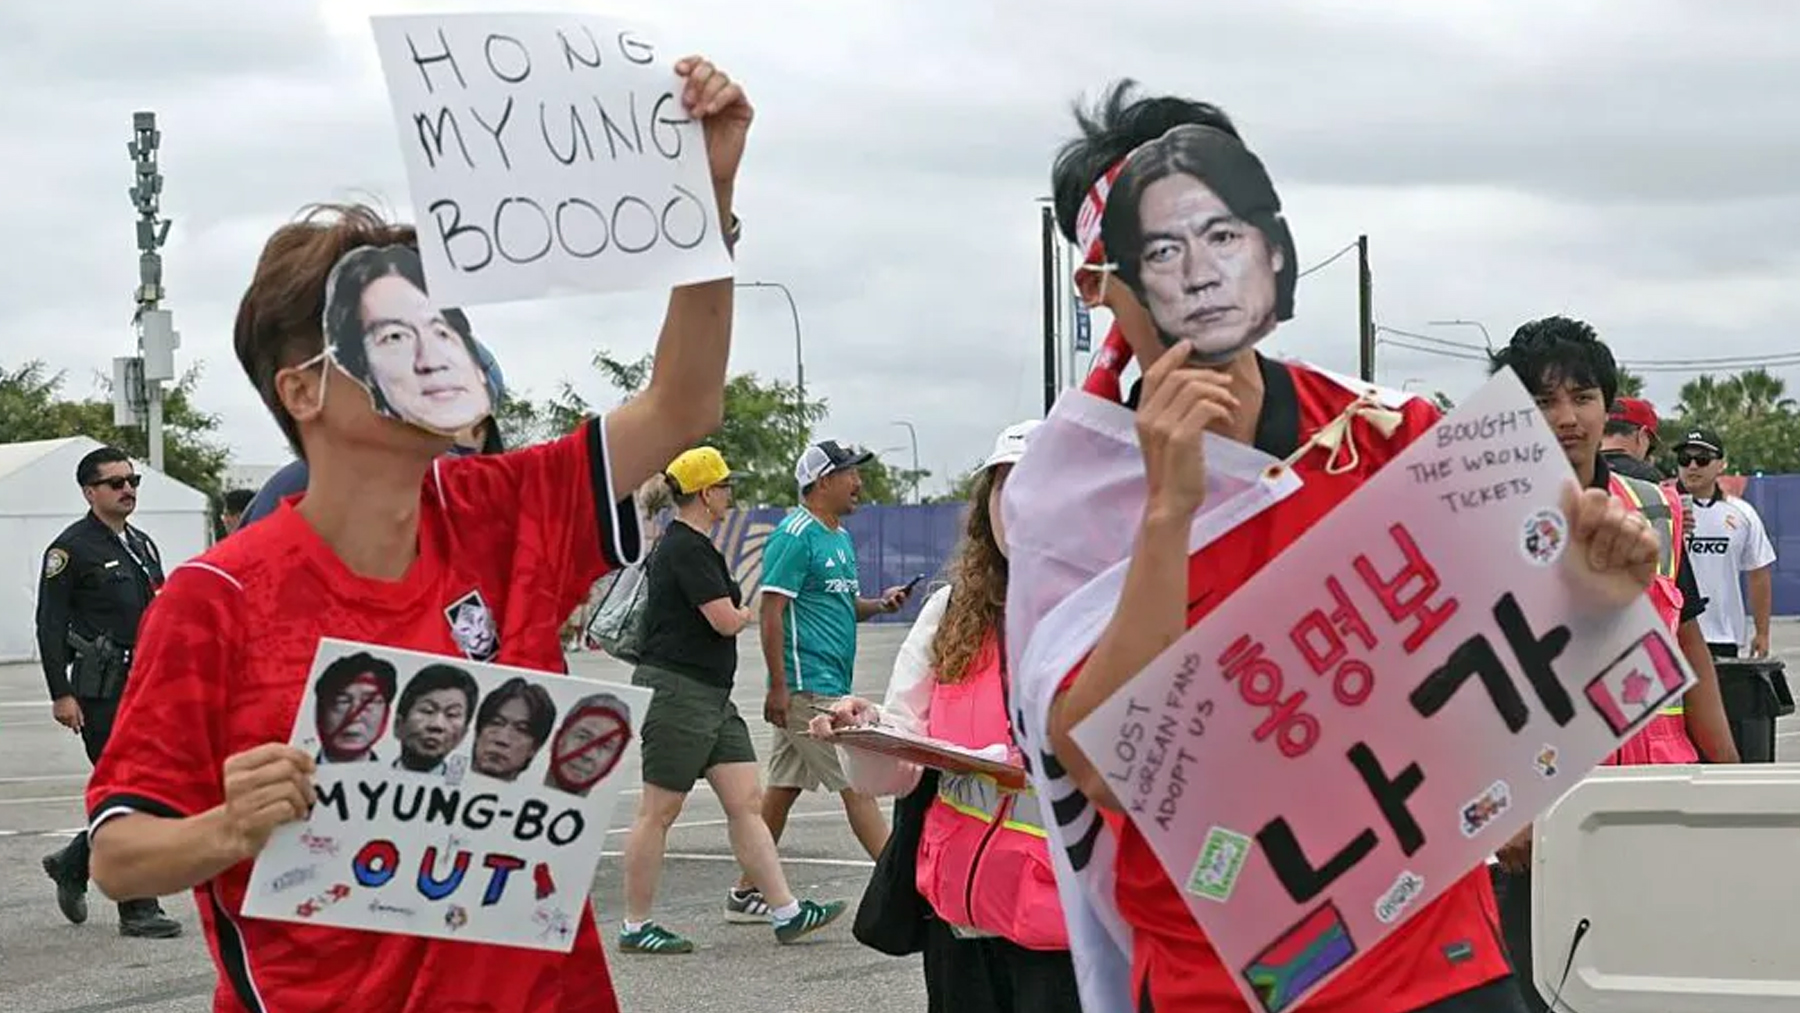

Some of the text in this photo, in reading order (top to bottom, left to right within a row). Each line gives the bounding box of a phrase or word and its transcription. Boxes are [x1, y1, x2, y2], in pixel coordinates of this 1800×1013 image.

[406, 26, 654, 93] HONG
[413, 92, 692, 170] MYUNG
[429, 185, 706, 272] BOOOO
[1406, 442, 1547, 483] THE WRONG
[1437, 408, 1534, 448] BOUGHT
[1440, 477, 1532, 512] TICKETS
[1218, 523, 1457, 758] 홍명보
[1107, 698, 1151, 782] LOST
[1131, 653, 1200, 814] KOREAN FANS
[1155, 699, 1214, 831] ADOPT US
[306, 781, 585, 846] MYUNG-BO
